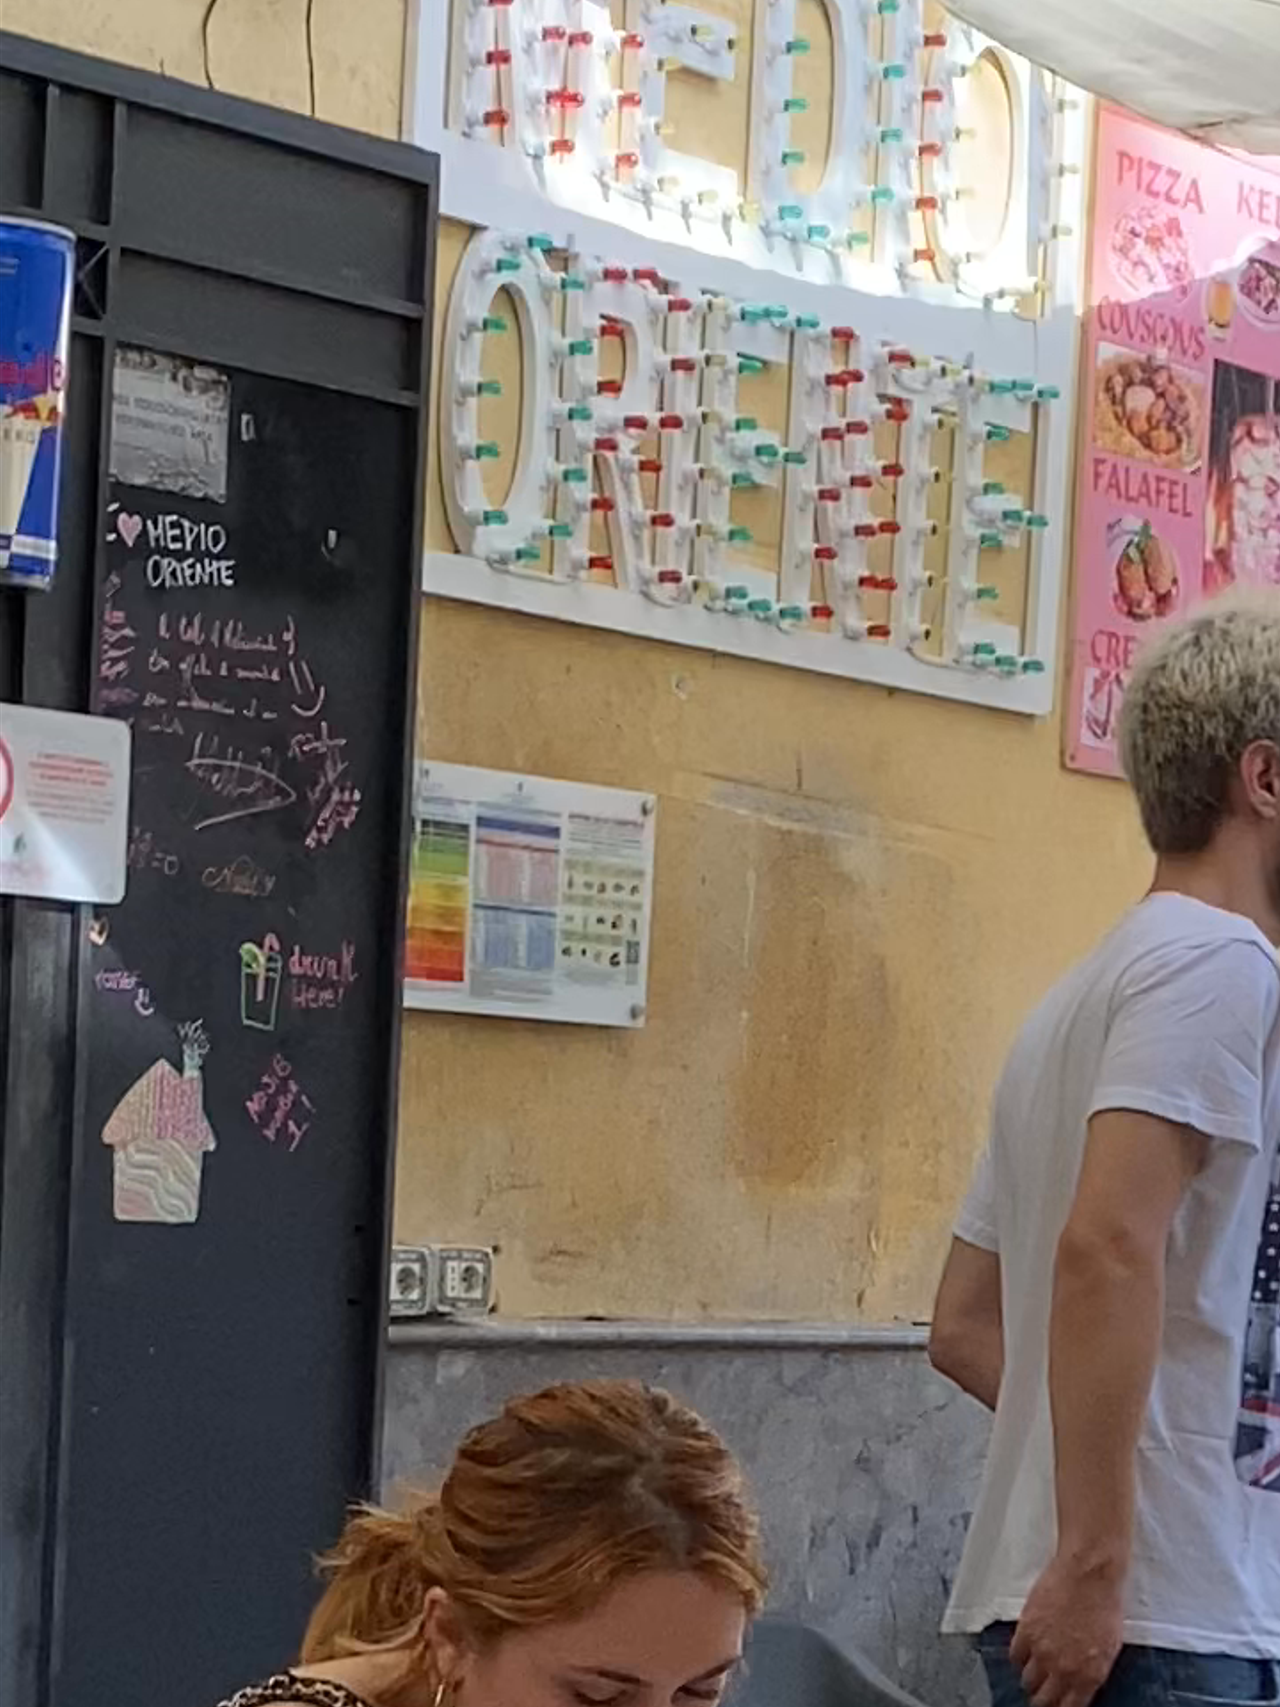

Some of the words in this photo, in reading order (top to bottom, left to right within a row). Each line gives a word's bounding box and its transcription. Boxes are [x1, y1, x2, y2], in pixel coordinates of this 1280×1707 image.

[1115, 150, 1206, 215] PIZZA
[440, 225, 1058, 678] ORIENTE
[1092, 457, 1193, 518] FALAFEL
[147, 514, 227, 554] MEDIO
[146, 554, 236, 589] ORIENTE
[1090, 628, 1138, 670] CRE
